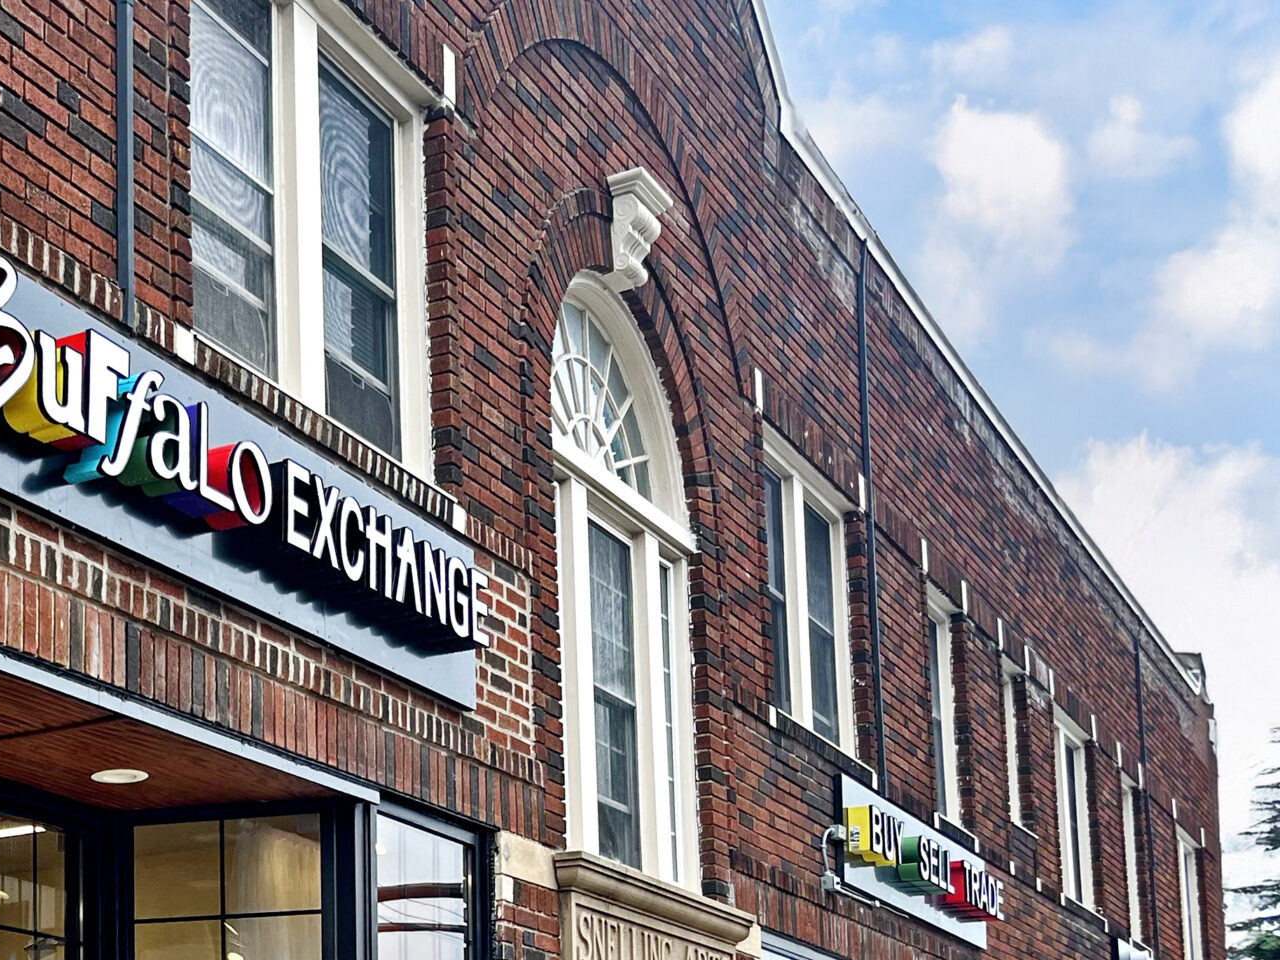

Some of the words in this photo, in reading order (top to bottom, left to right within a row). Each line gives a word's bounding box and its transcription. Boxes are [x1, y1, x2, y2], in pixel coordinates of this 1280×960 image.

[286, 458, 491, 649] EXCHANGE
[870, 804, 904, 863] BUY
[919, 836, 955, 895] SELL
[963, 860, 1005, 921] TRADE
